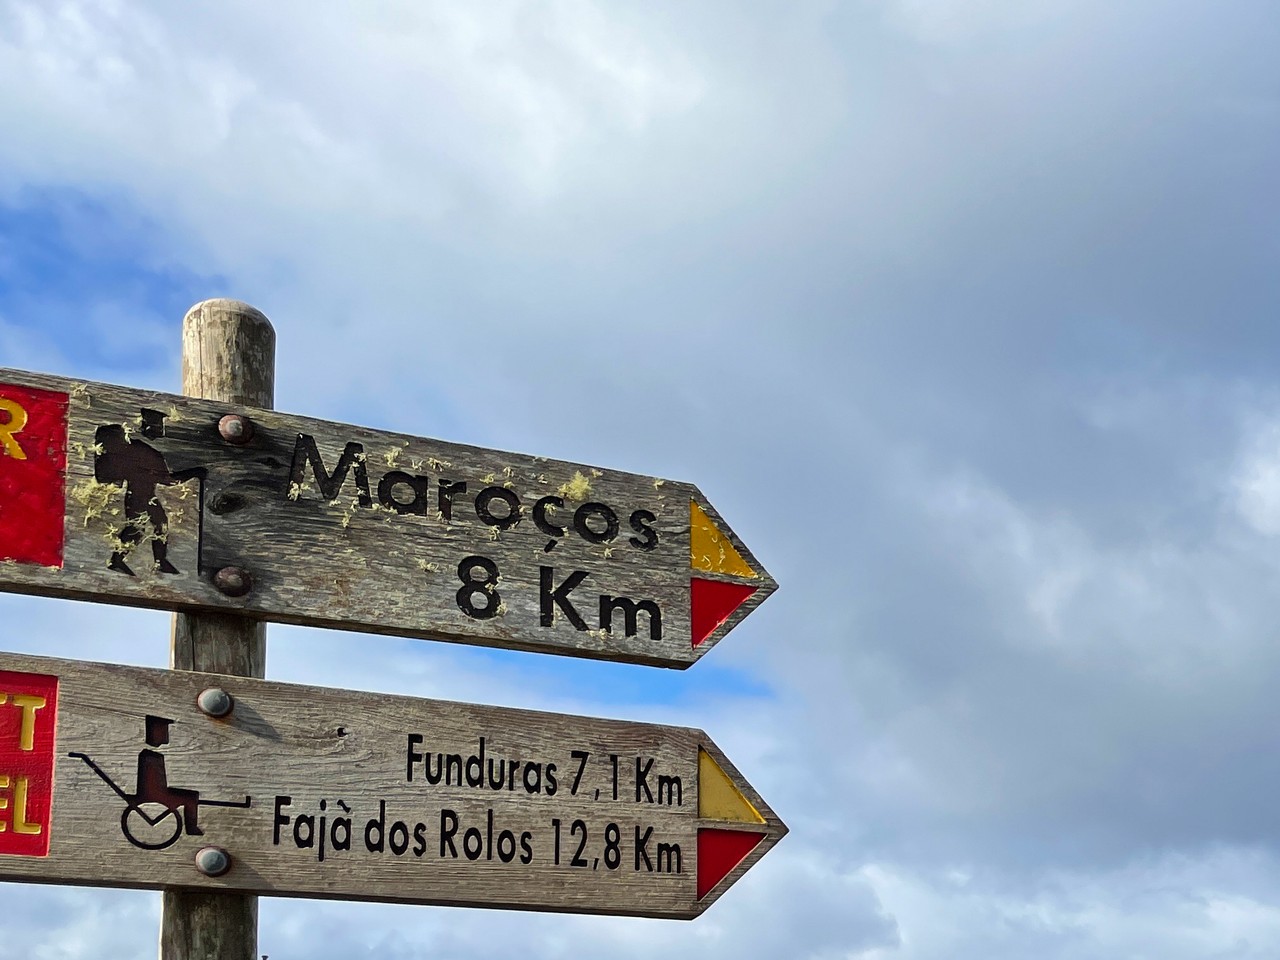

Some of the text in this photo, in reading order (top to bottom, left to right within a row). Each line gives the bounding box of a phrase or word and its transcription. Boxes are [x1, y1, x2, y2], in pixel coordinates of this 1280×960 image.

[288, 432, 660, 553] Maroços
[455, 556, 662, 641] 8 Km
[0, 693, 47, 751] T
[406, 733, 683, 807] Funduras 7,1 Km
[364, 799, 427, 858] dos
[440, 808, 534, 866] Rolos
[553, 818, 622, 871] 12,8
[634, 825, 682, 874] Km
